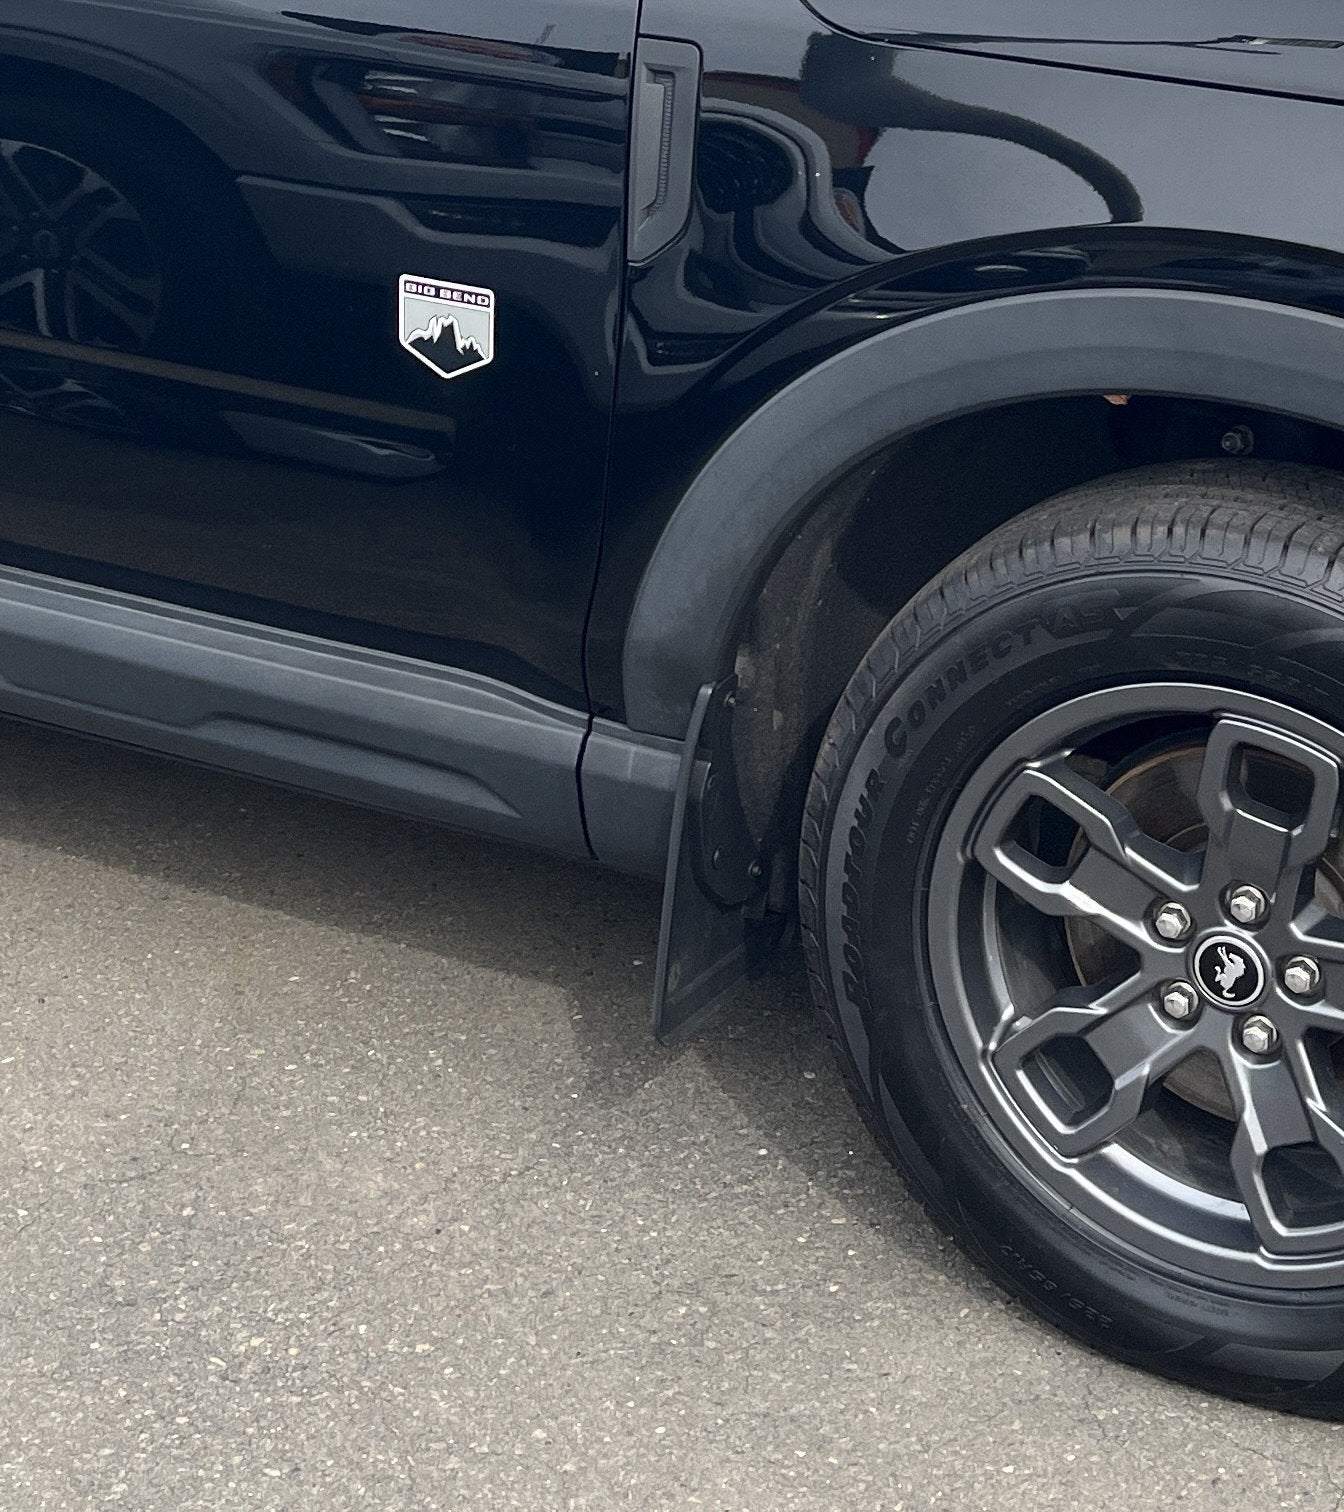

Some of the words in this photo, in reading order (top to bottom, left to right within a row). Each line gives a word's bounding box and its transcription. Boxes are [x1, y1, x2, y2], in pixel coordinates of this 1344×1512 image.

[405, 282, 436, 297] BIG
[439, 287, 490, 307] BEND
[883, 619, 1044, 758] CONNECT
